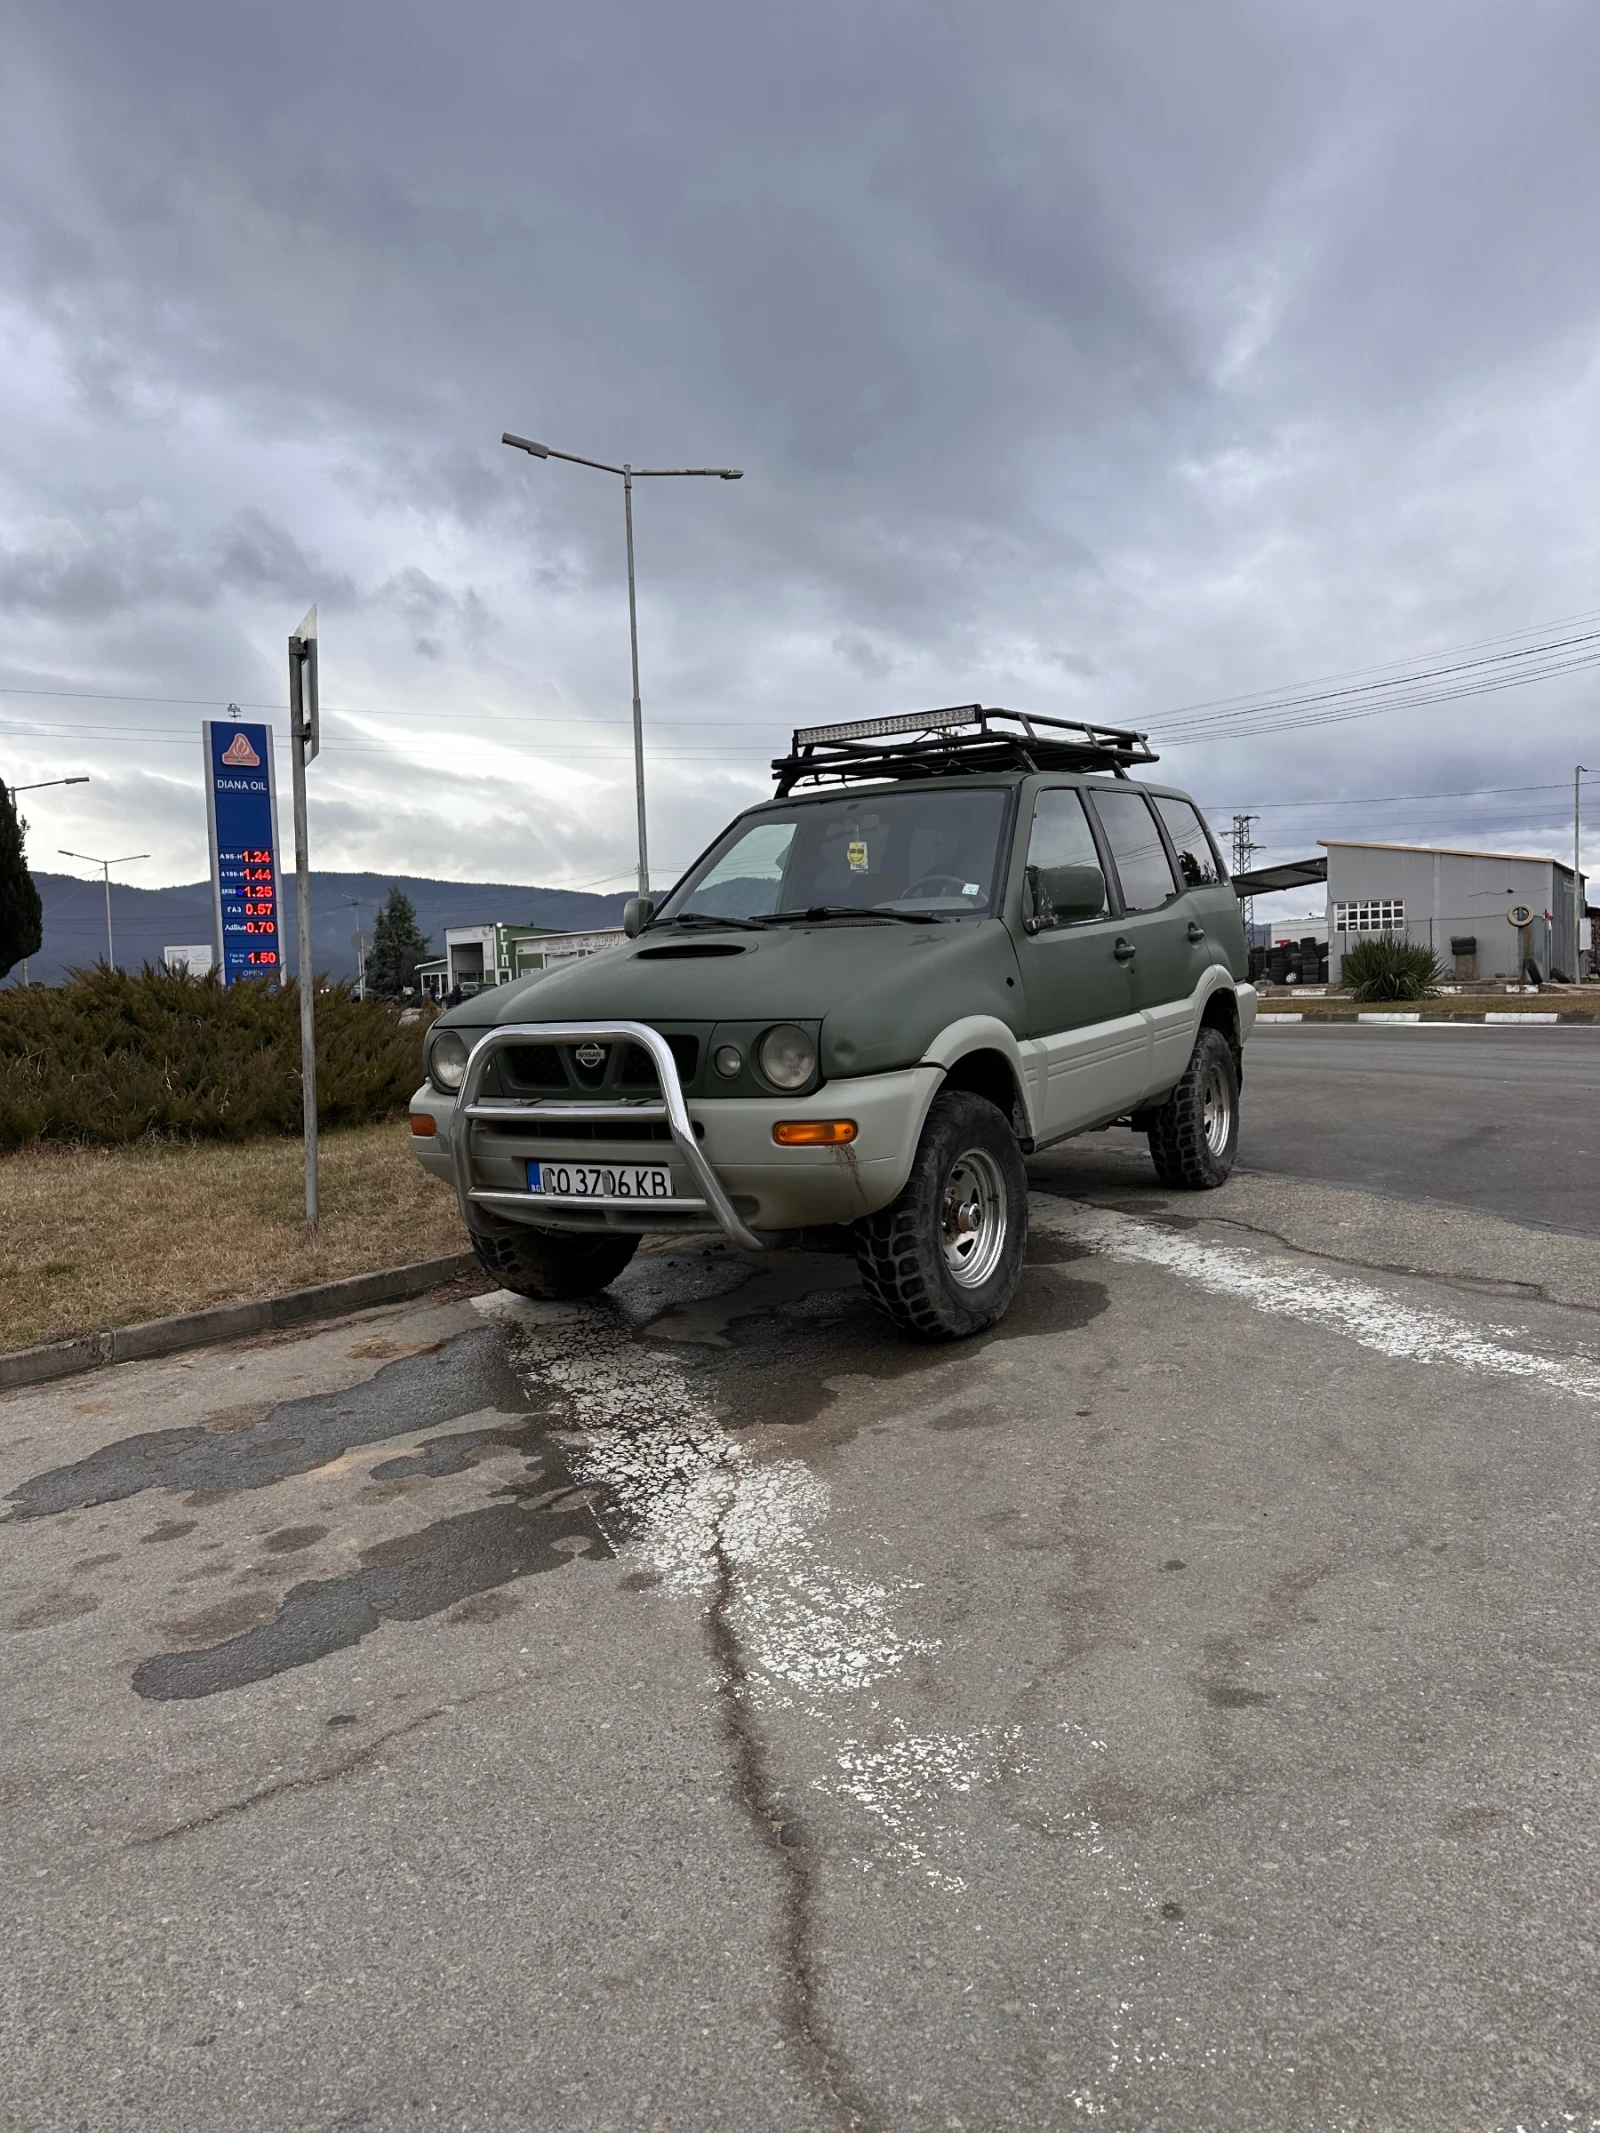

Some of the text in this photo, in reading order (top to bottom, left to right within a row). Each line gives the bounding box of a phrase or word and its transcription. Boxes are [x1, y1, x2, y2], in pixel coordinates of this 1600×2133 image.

[217, 780, 267, 790] DIANA OIL
[243, 851, 271, 863] 1.24
[244, 869, 272, 880] 1.44
[244, 886, 273, 898] 1.25
[245, 903, 273, 916] 0.57
[246, 922, 275, 933] 0.70
[248, 952, 276, 964] 1.50
[531, 1184, 541, 1193] BG
